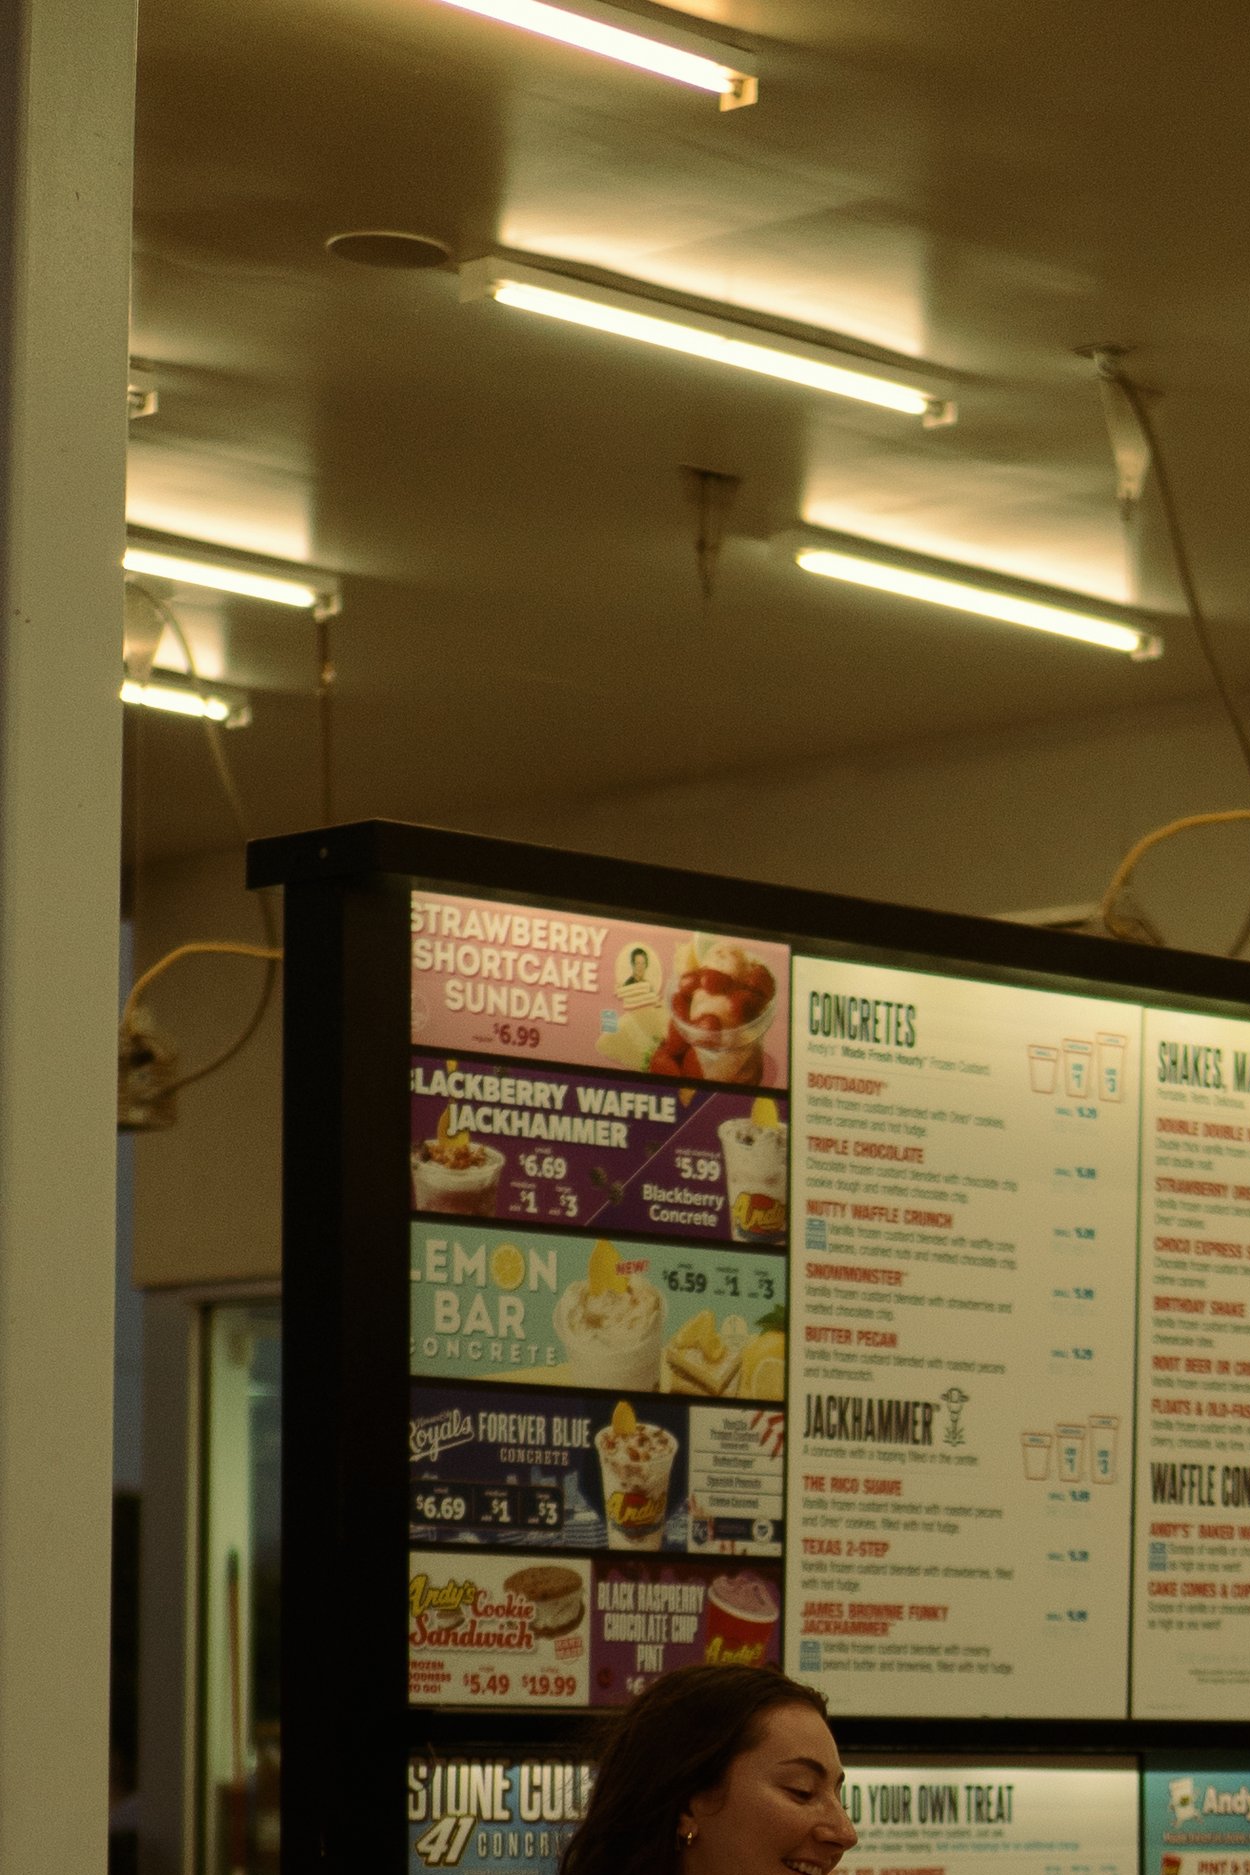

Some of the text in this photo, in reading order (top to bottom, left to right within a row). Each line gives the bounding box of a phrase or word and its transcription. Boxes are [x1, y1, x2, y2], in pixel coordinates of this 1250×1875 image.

[411, 901, 609, 957] STRAWBERRY
[413, 938, 599, 993] SHORTCAKE
[445, 979, 569, 1025] SUNDAE
[493, 1022, 542, 1048] $6.99
[808, 990, 917, 1049] CONCRETES
[578, 1088, 676, 1123] WAFFLE
[448, 1104, 629, 1149] JACKHAMMER
[807, 1136, 924, 1164] TRIPLE CHOCOLATE
[520, 1154, 567, 1180] $6.69
[675, 1156, 721, 1181] $5.99
[642, 1184, 724, 1211] Blackberry
[852, 1204, 899, 1223] WAFFLE
[649, 1204, 718, 1227] Concrete
[662, 1268, 708, 1294] $6.59
[435, 1290, 526, 1340] BAR
[477, 1411, 546, 1446] FOREVER
[552, 1416, 592, 1448] BLUE
[803, 1393, 934, 1446] JACKHAMMER
[500, 1448, 570, 1466] CONCRETE
[1150, 1462, 1216, 1507] WAFFLE
[416, 1494, 466, 1520] $6.69
[802, 1539, 841, 1555] TEXAS
[409, 1574, 535, 1618] Andy's Cookie
[597, 1581, 705, 1613] BLACK RASPBERRY
[409, 1612, 533, 1649] Sandwich
[604, 1613, 667, 1642] CHOCOLATE
[637, 1644, 664, 1672] PINT
[463, 1673, 510, 1695] $5.49
[408, 1764, 511, 1820] STONE
[869, 1785, 1014, 1825] YOUR OWN TREAT
[417, 1815, 476, 1867] 41
[1198, 1861, 1226, 1875] PINT
